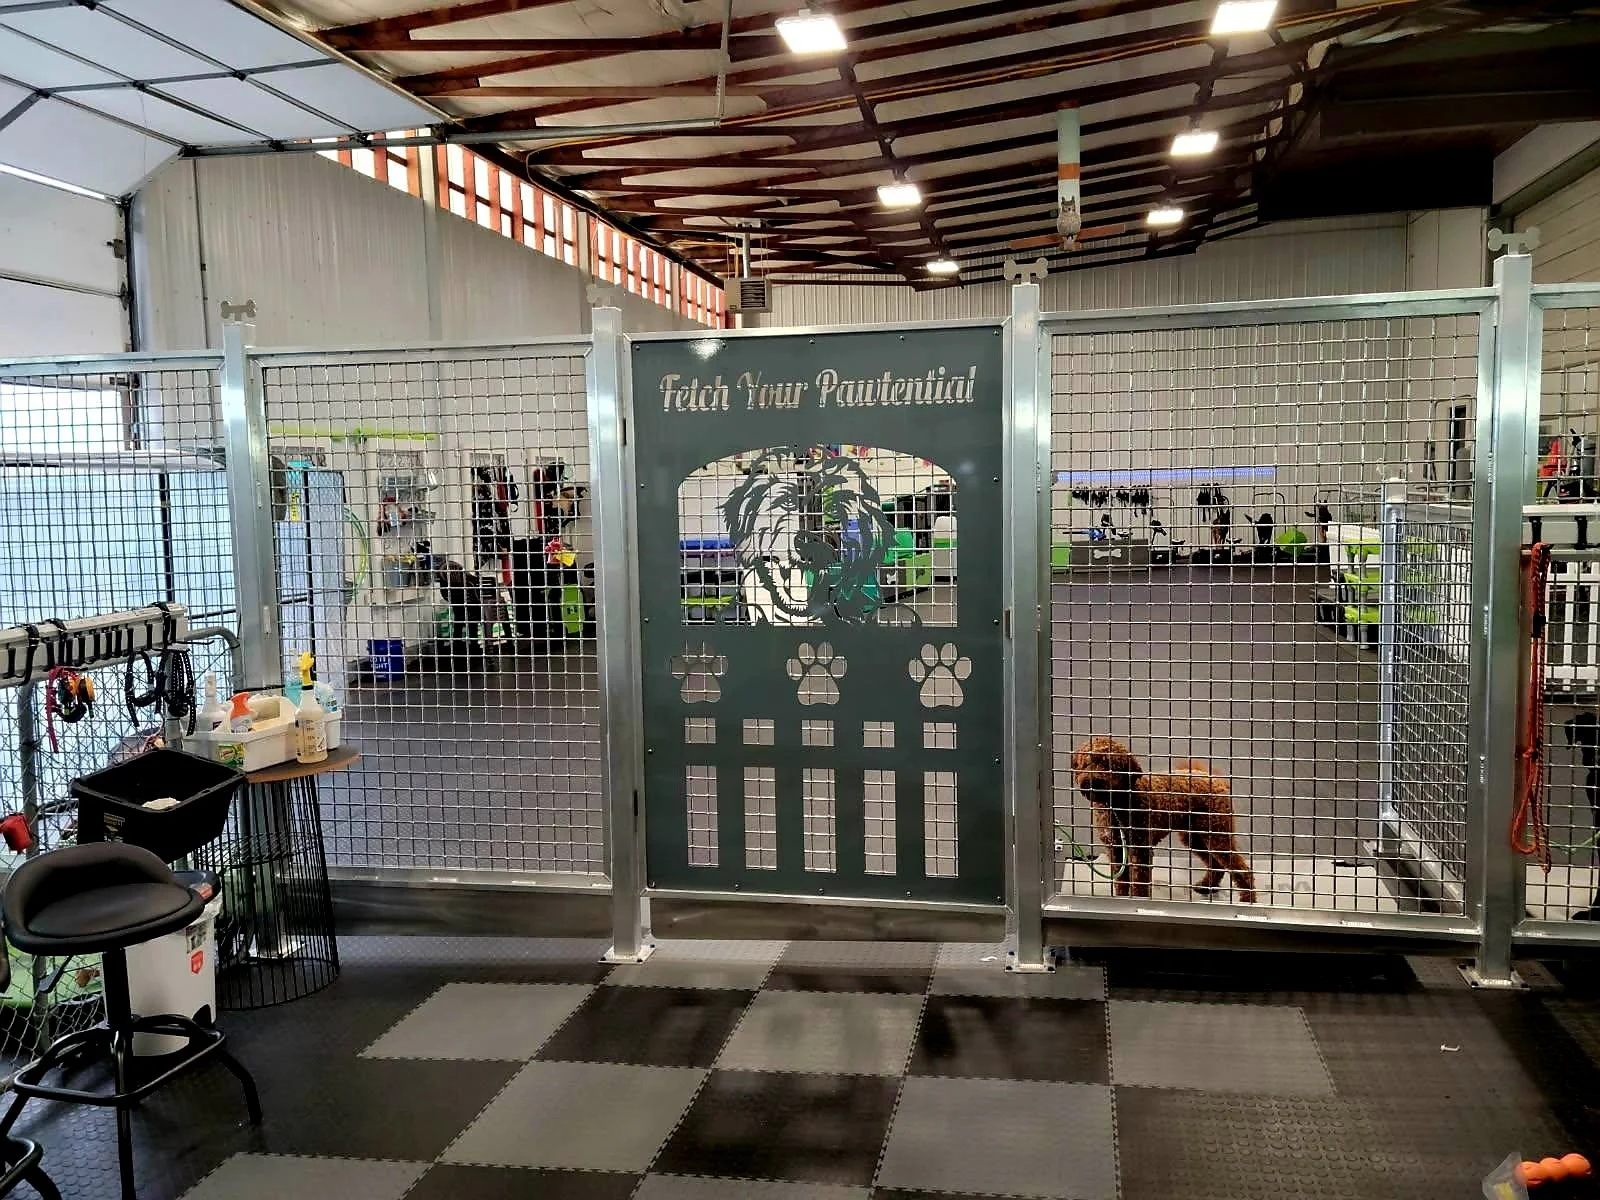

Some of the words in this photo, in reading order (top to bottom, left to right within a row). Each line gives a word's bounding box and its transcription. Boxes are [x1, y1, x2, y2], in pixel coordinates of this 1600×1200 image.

[659, 373, 730, 412] Fetch
[736, 370, 809, 411] Your
[815, 365, 978, 408] Pawtential
